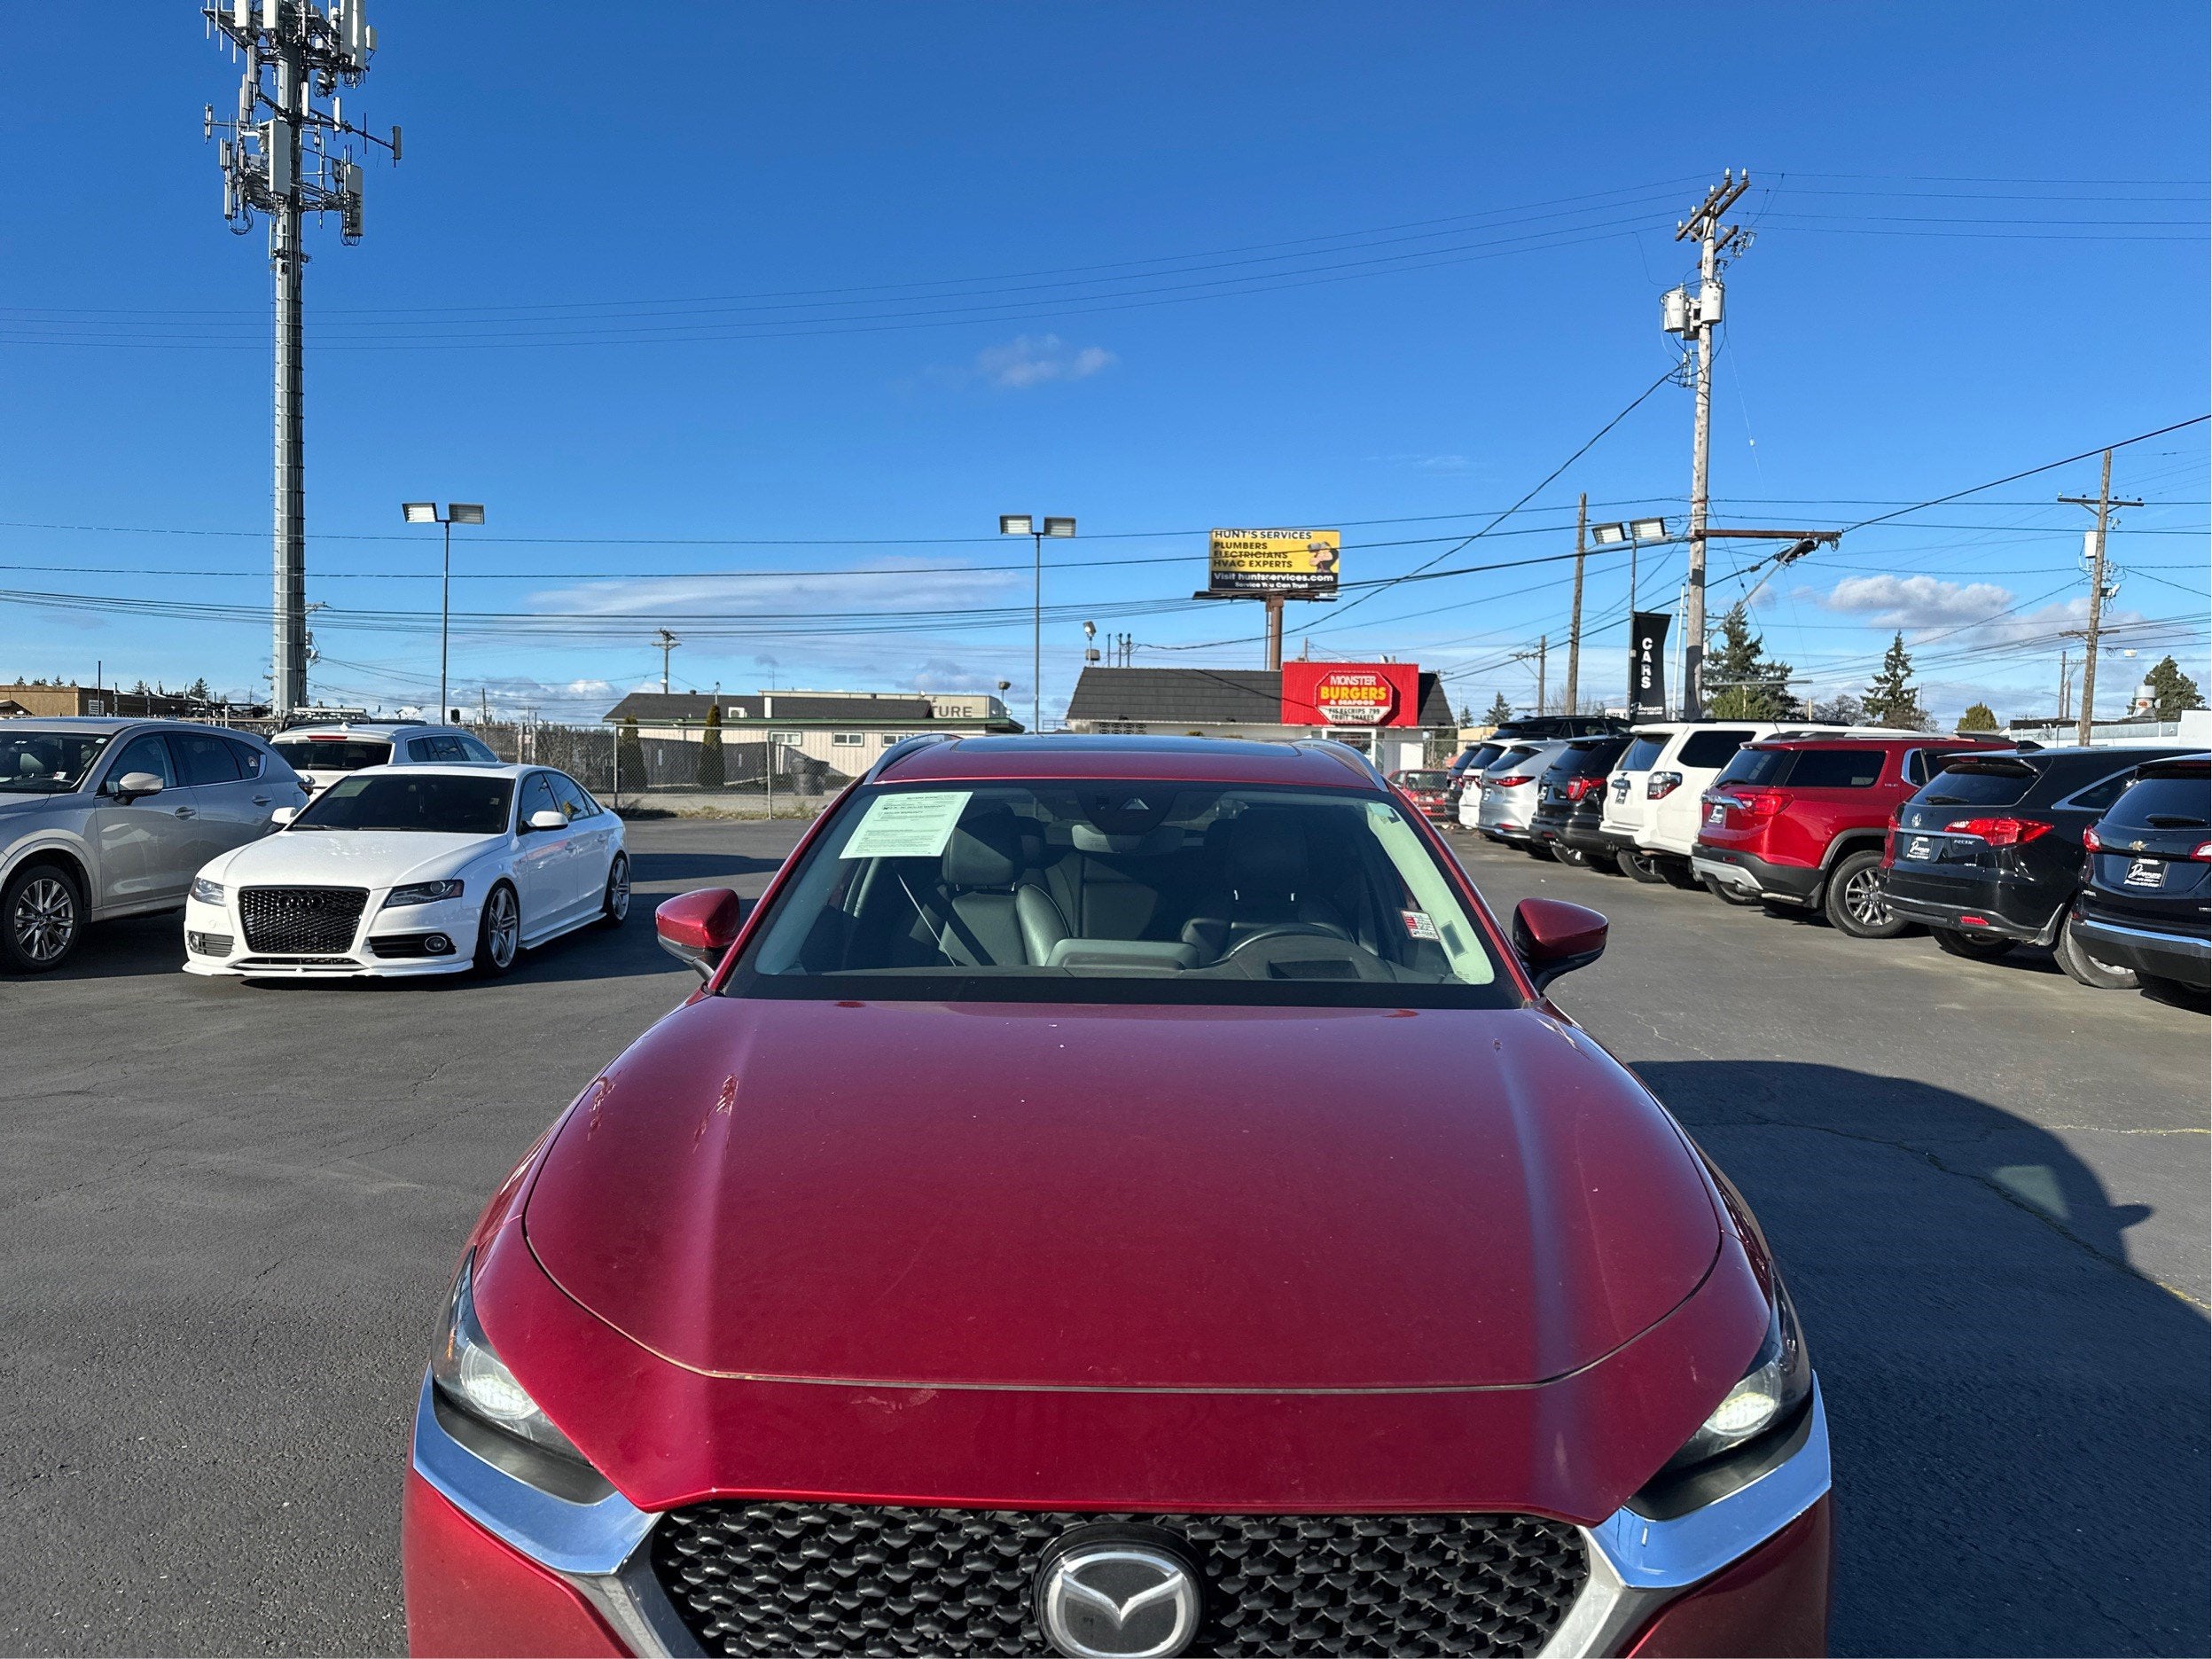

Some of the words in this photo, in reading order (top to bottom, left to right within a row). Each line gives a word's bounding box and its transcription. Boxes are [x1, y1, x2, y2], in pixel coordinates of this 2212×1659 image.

[1641, 637, 1653, 689] CARS
[1331, 676, 1376, 685] MONSTER
[1321, 686, 1387, 700] BURGERS
